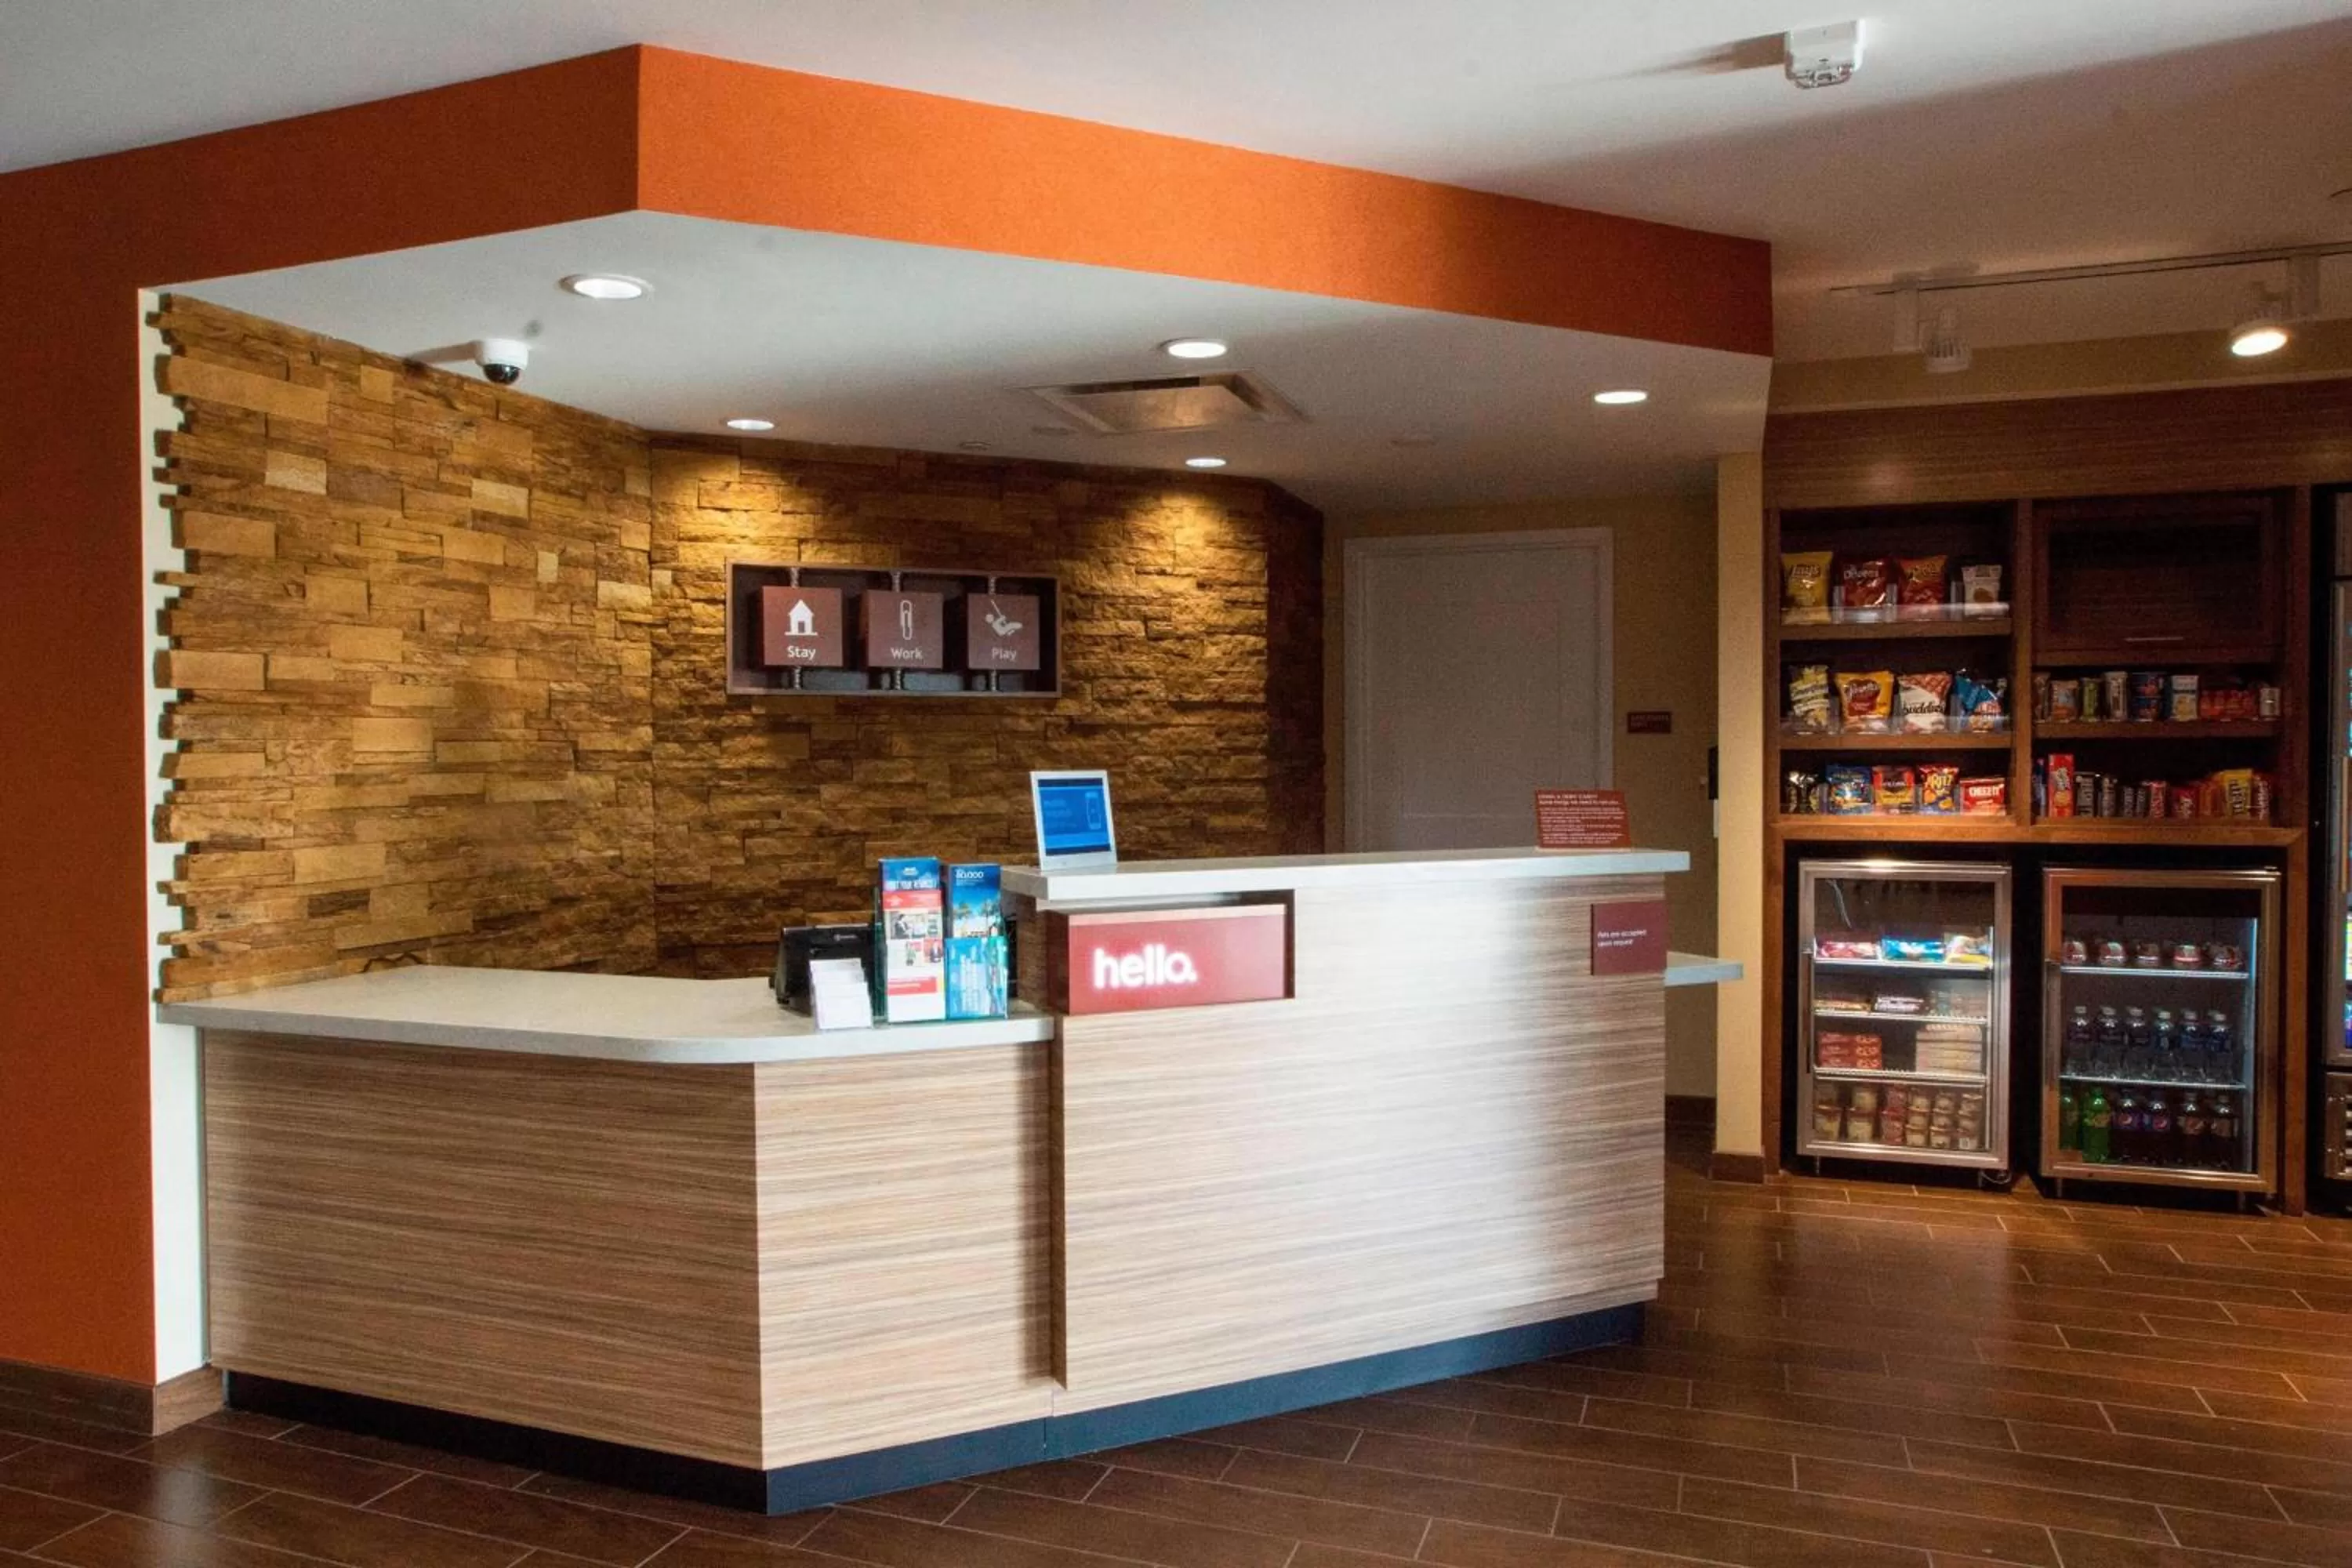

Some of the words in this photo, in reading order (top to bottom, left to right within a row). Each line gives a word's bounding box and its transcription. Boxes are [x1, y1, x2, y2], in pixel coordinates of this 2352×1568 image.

[787, 645, 816, 661] Stay
[891, 647, 924, 660] Work
[992, 648, 1017, 662] Play
[1092, 943, 1199, 990] hello.
